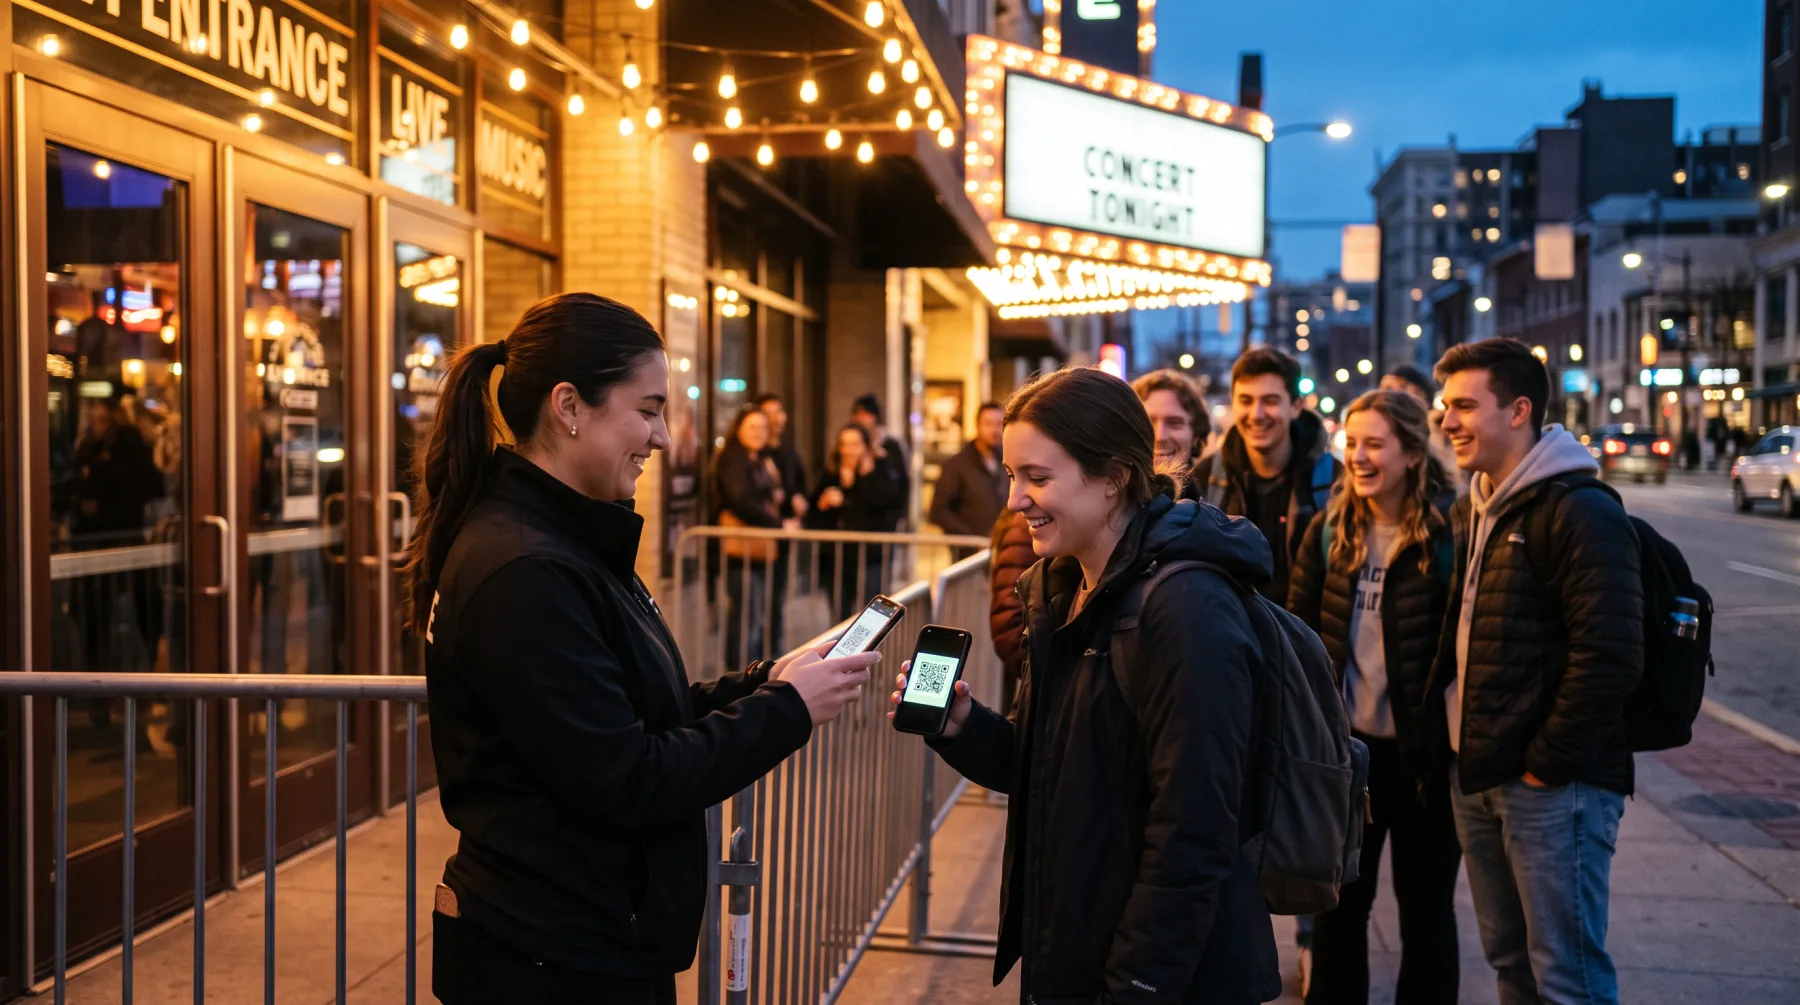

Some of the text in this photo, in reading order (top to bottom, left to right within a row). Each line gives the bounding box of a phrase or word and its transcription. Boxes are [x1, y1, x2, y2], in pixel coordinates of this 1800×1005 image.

[391, 74, 449, 156] LIVE
[480, 119, 547, 199] MUSIC
[1085, 145, 1195, 196] CONCERT
[1090, 189, 1194, 234] TONIGHT
